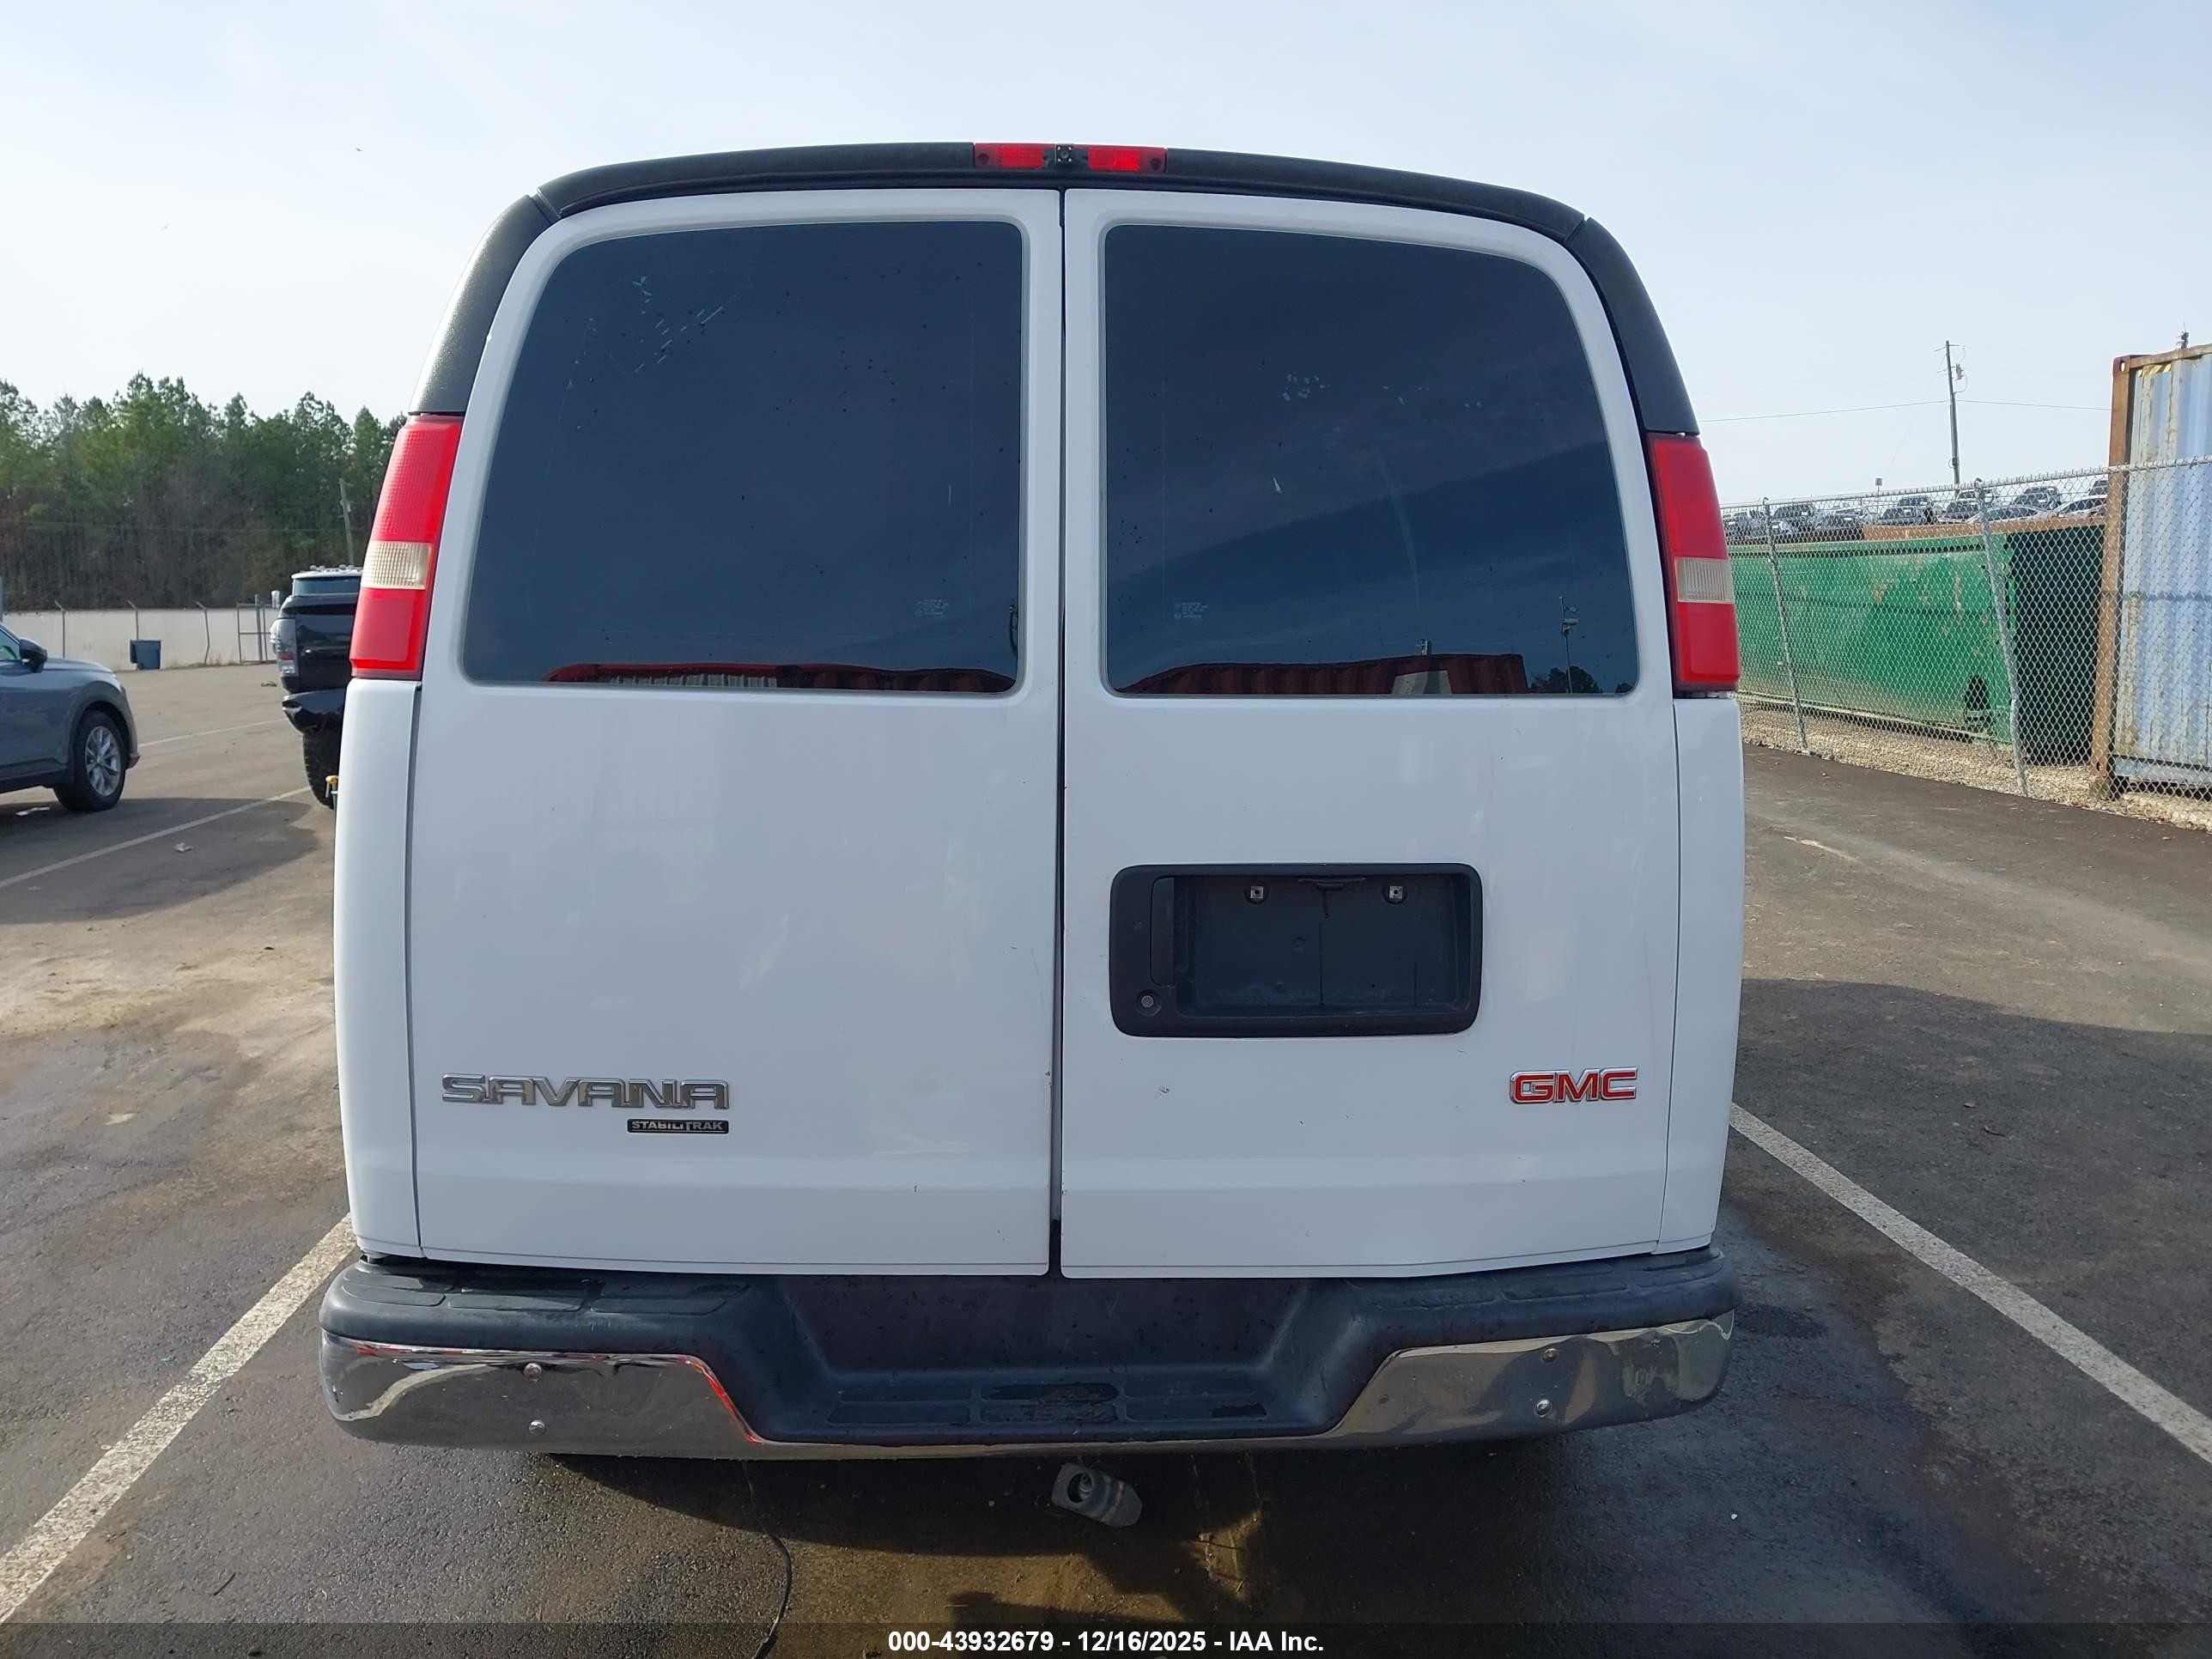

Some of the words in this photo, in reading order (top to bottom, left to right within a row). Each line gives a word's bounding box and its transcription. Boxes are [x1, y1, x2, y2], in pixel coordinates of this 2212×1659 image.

[441, 1073, 730, 1109] SAVANA
[1510, 1067, 1638, 1104] GMC
[631, 1120, 724, 1131] STABILITRAK
